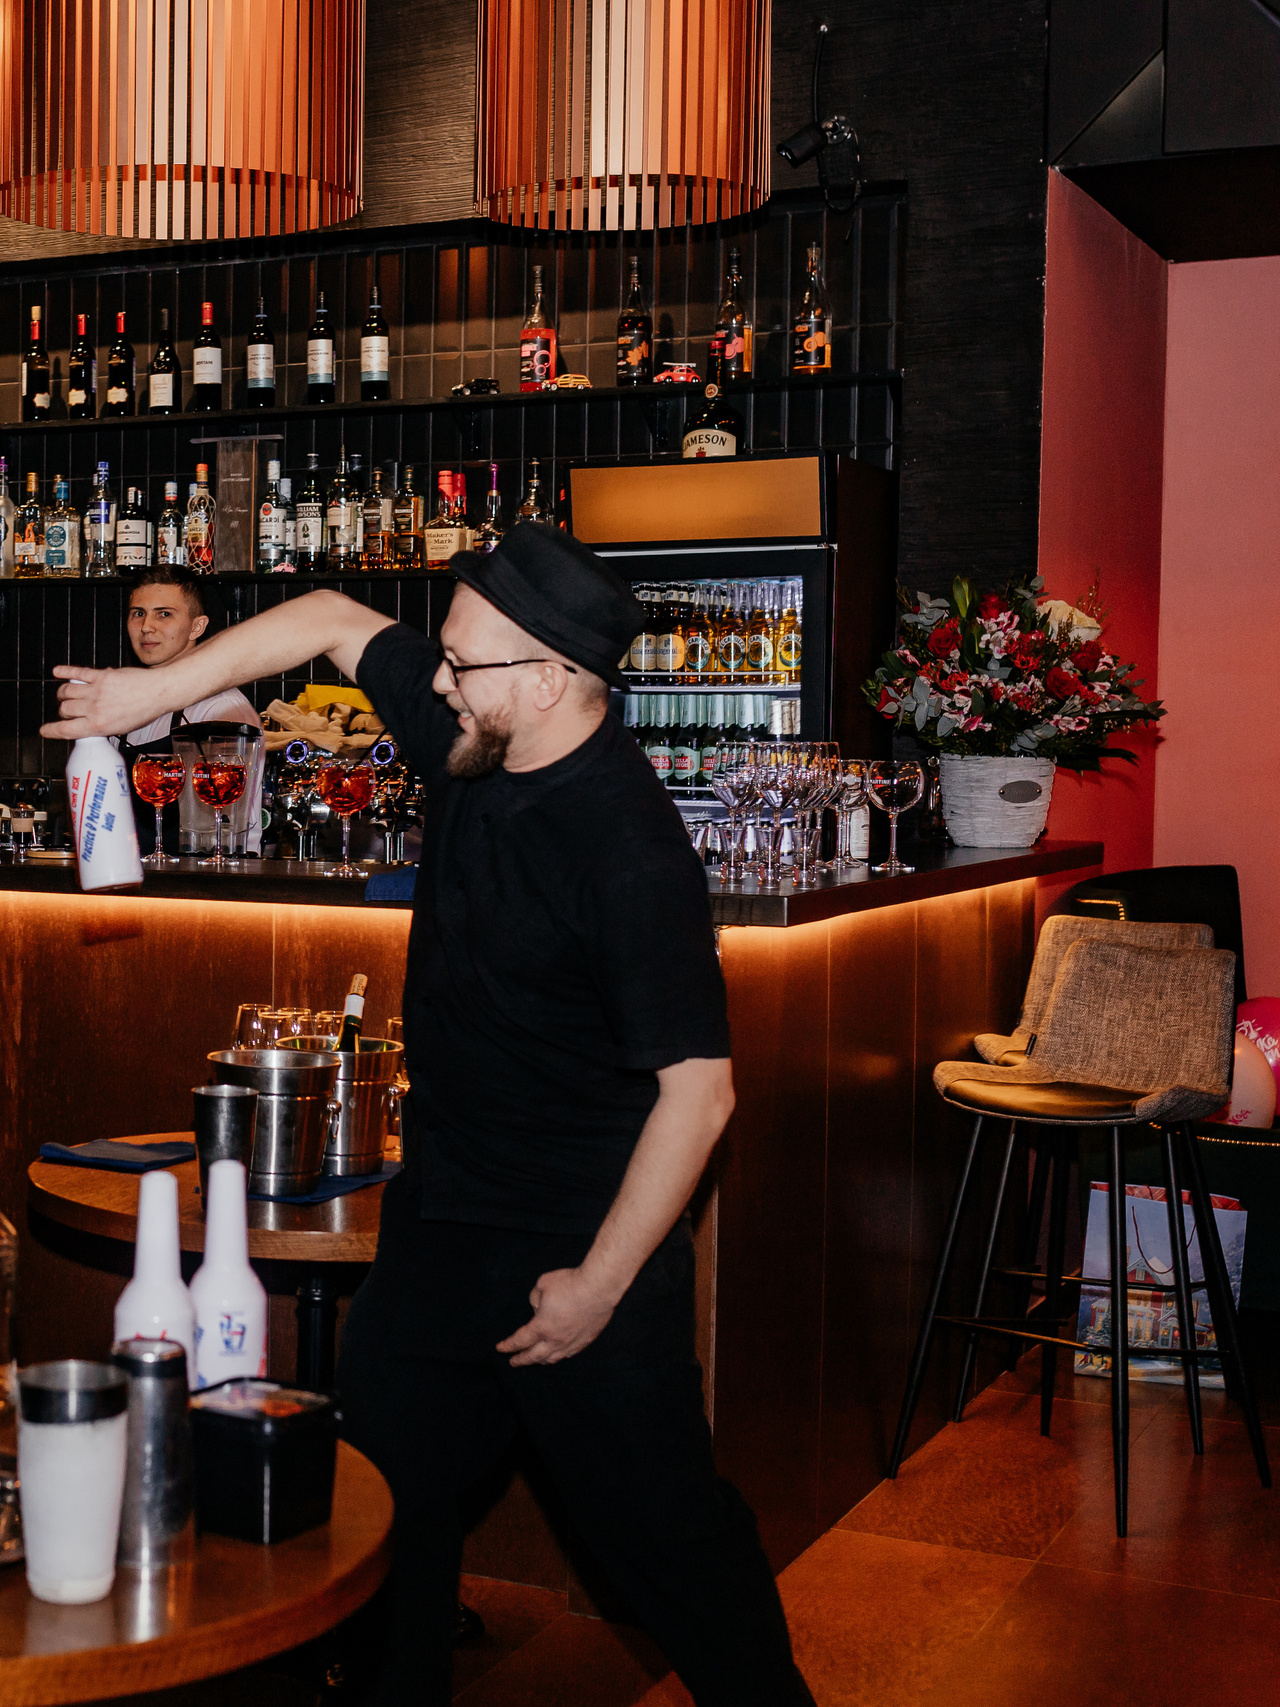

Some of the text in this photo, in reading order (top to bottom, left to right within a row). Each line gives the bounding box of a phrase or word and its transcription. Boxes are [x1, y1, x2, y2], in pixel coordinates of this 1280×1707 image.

[683, 433, 728, 452] JAMESON
[426, 531, 454, 539] Maker's
[86, 775, 108, 825] Performance
[81, 830, 96, 863] Practice
